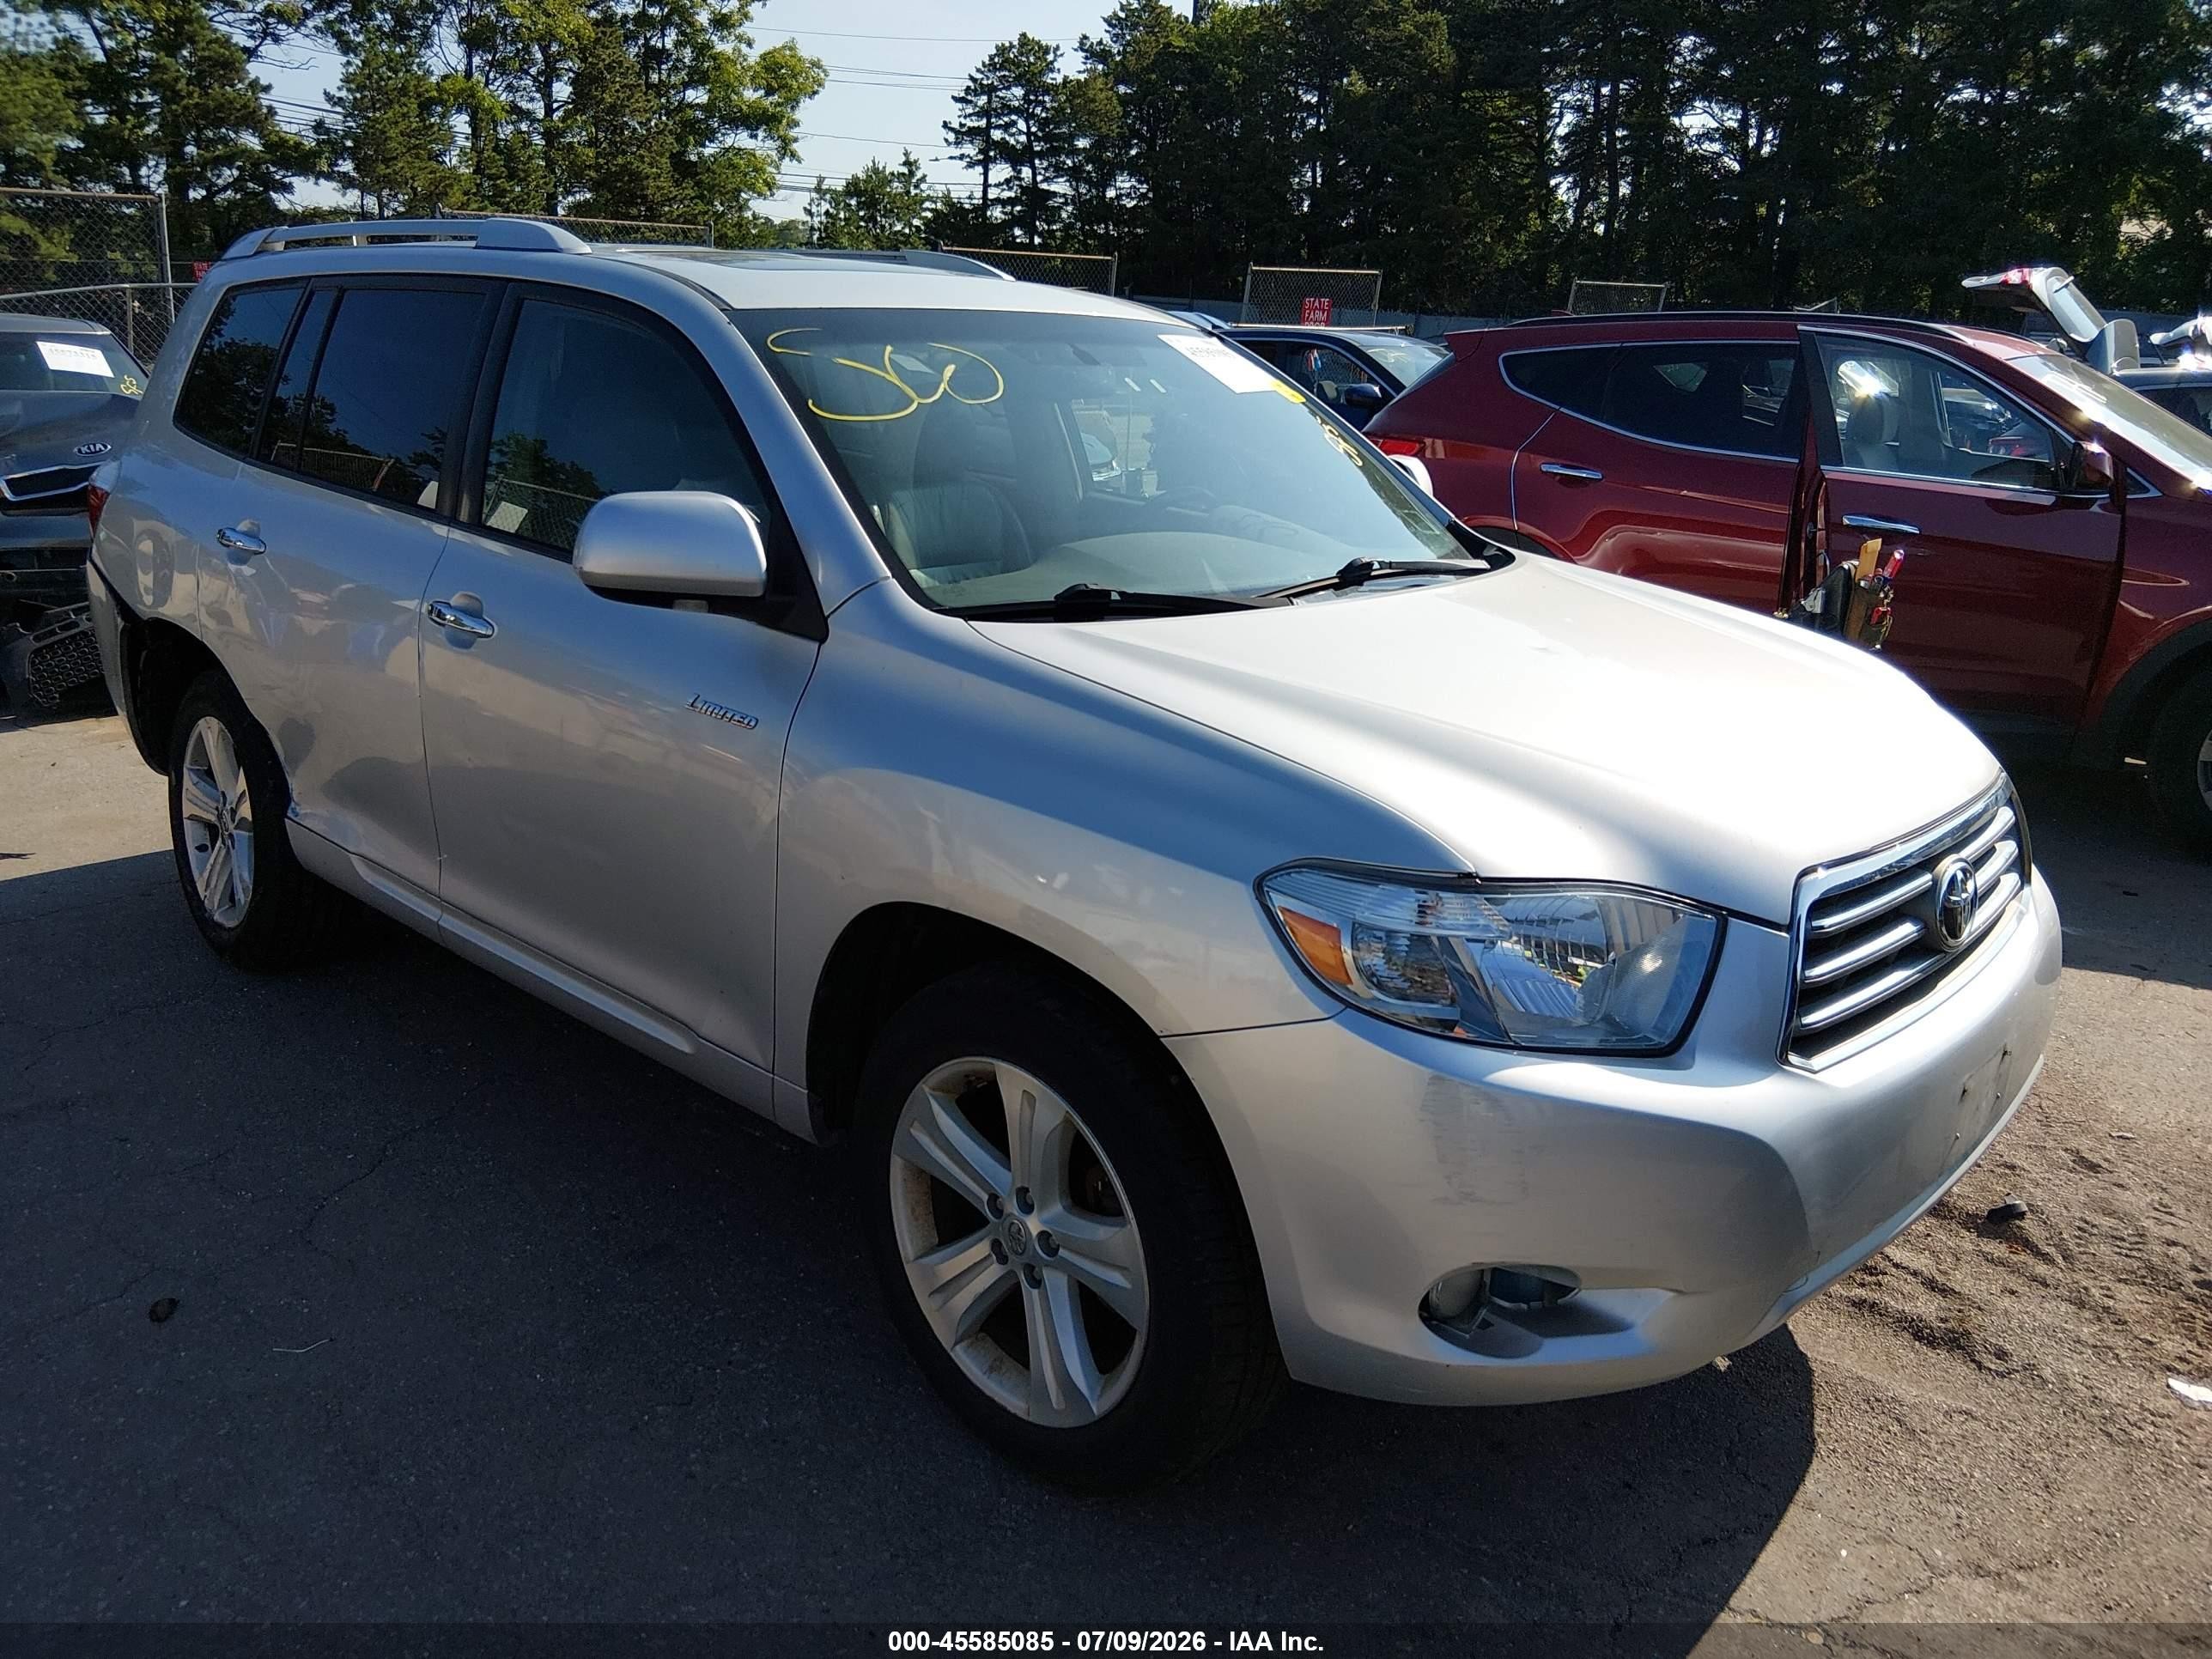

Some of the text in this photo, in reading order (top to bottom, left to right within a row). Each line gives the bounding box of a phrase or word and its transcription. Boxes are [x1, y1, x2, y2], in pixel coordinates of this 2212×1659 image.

[1305, 297, 1329, 309] STATE
[1305, 310, 1328, 321] FARM
[81, 443, 106, 454] KIA
